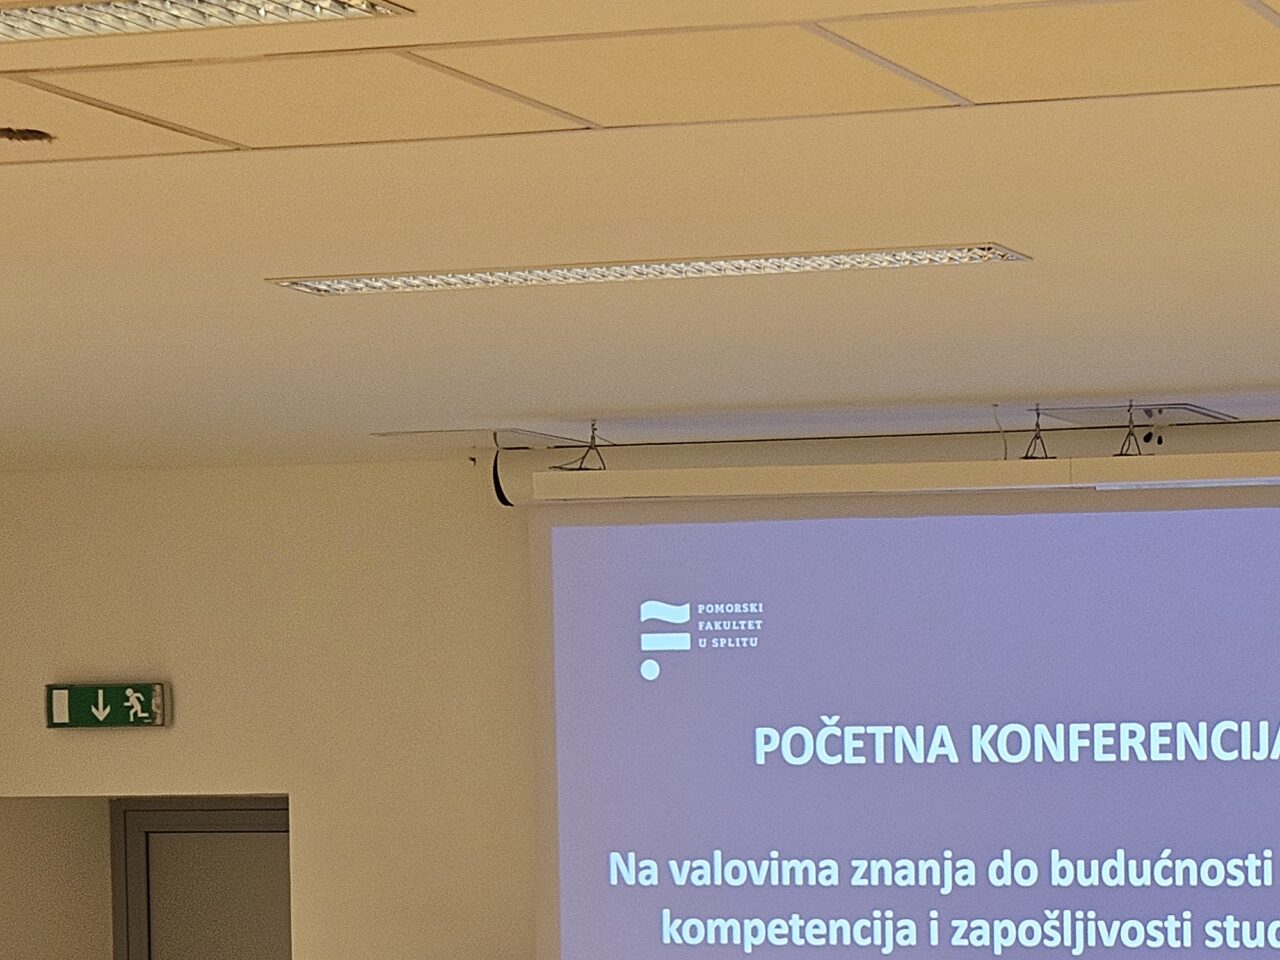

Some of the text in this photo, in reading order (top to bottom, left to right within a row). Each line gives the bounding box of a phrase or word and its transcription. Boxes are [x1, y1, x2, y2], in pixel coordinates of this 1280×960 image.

[697, 602, 764, 614] POMORSKI
[698, 620, 763, 631] FAKULTET
[698, 637, 758, 648] U SPLITU
[755, 715, 959, 766] POČETNA
[609, 851, 659, 886] Na
[668, 849, 839, 887] valovima
[850, 849, 976, 895] znanja
[988, 848, 1039, 887] do
[1051, 848, 1273, 887] budućnosti
[662, 908, 917, 955] kompetencija
[929, 909, 939, 946] i
[950, 909, 1192, 956] zapošljivosti
